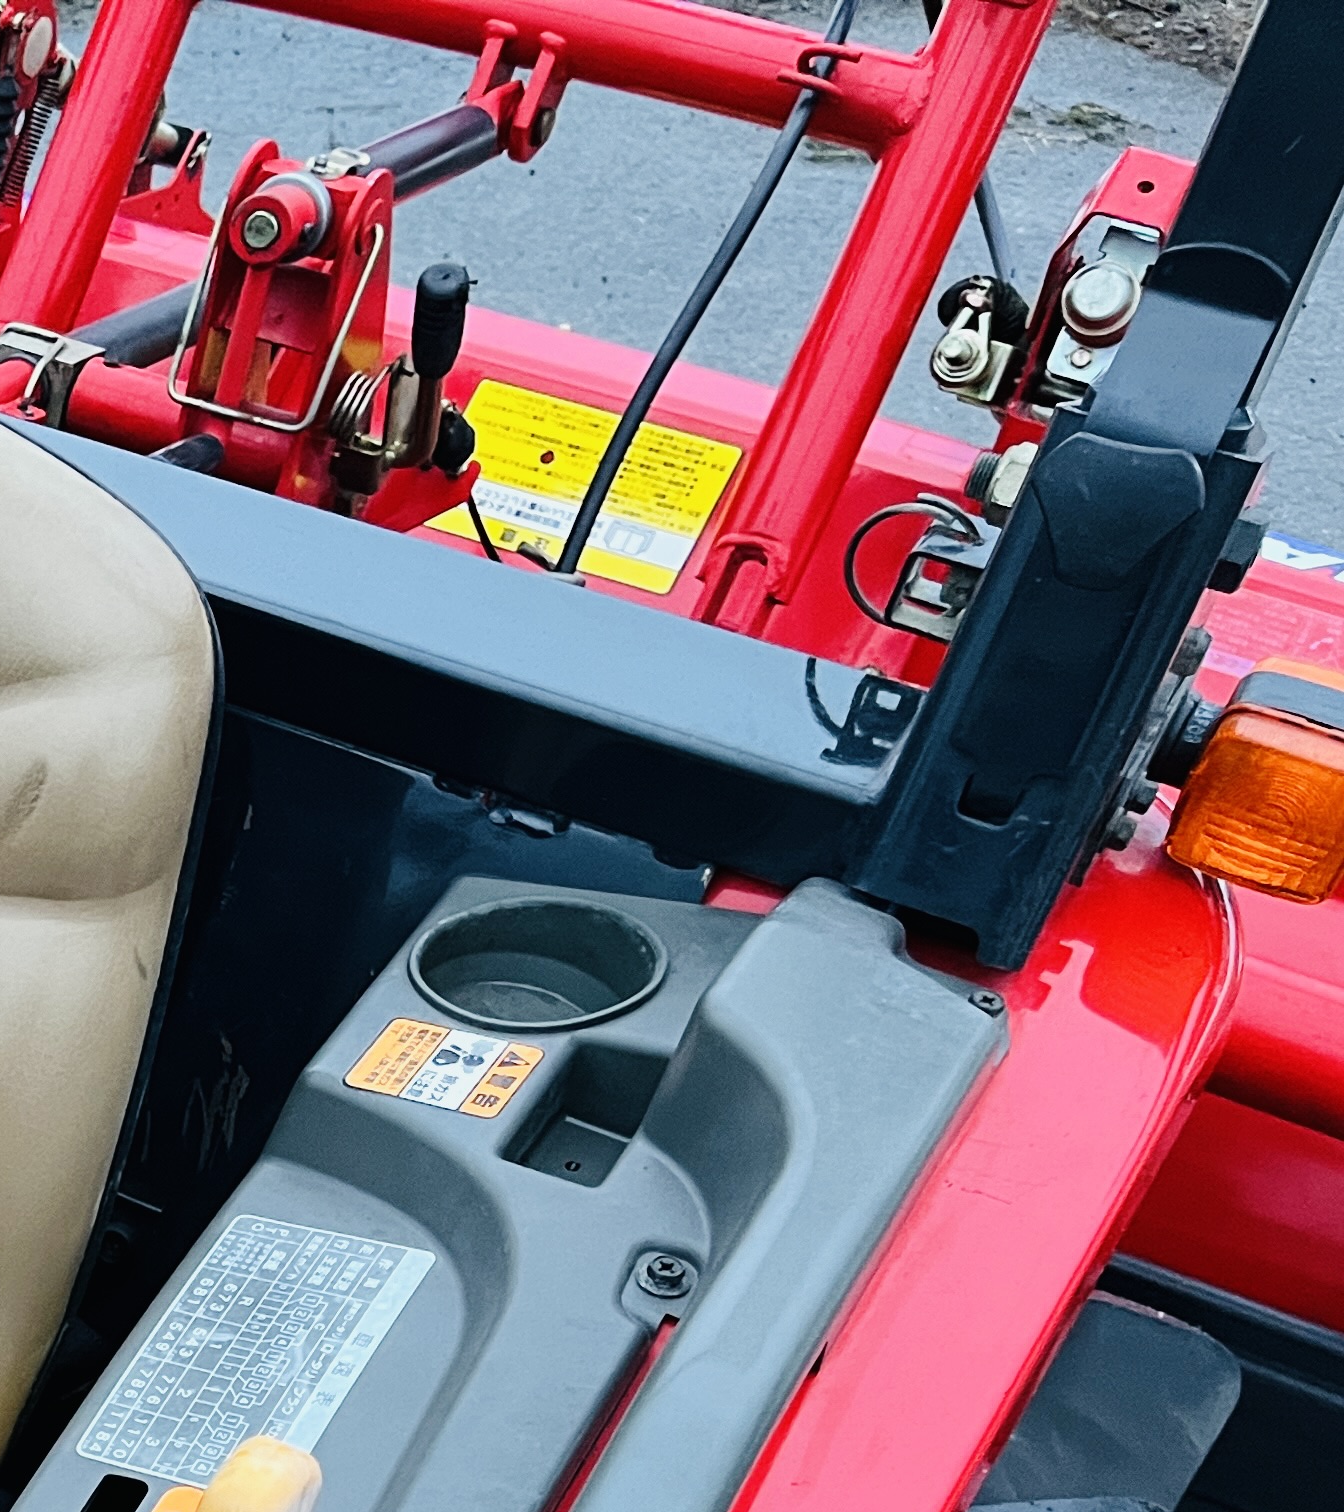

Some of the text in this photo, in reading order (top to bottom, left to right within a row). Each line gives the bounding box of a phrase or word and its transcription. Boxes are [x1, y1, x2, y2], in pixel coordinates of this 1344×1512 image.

[185, 1277, 215, 1305] 681
[207, 1282, 239, 1312] 673
[237, 1295, 255, 1306] R
[144, 1373, 176, 1405] 776
[174, 1387, 193, 1398] 2
[86, 1410, 125, 1452] 1184
[108, 1416, 149, 1459] 1170
[143, 1436, 161, 1447] 3
